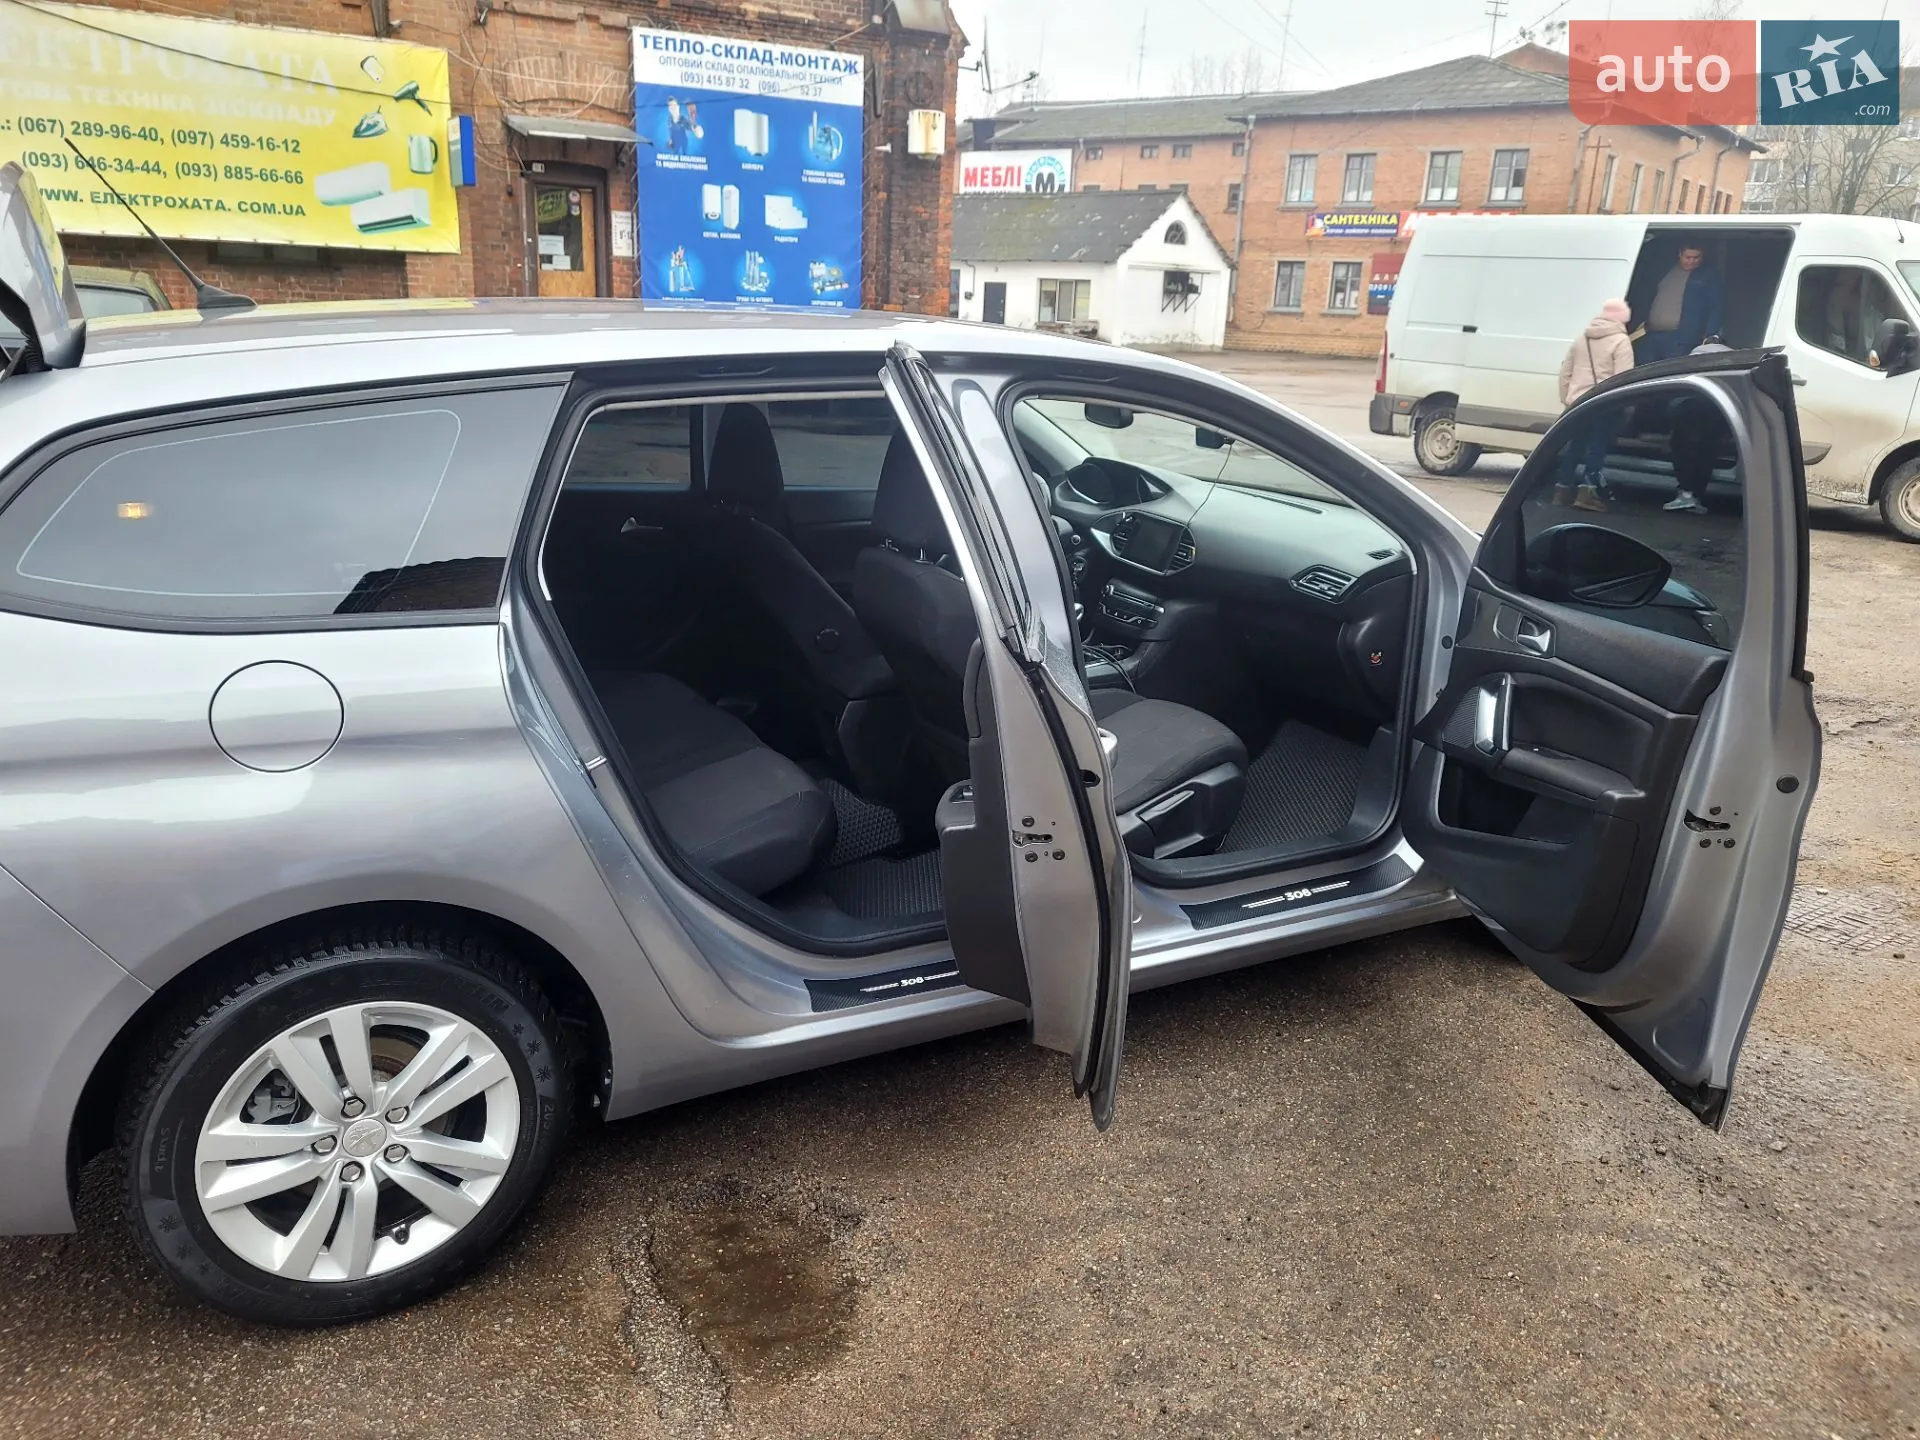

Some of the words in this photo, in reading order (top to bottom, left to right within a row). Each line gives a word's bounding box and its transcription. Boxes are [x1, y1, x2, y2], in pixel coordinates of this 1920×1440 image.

[640, 34, 858, 74] ТЕПЛО-СКЛАД-МОНТАЖ
[681, 72, 704, 86] (093)
[706, 74, 723, 86] 415
[725, 76, 736, 87] 87
[739, 78, 750, 89] 32
[17, 116, 65, 138] (067)
[70, 120, 165, 146] 289-96-40,
[171, 128, 215, 150] (097)
[220, 132, 301, 154] 459-16-12
[22, 151, 69, 172] (093)
[74, 154, 168, 179] 646-34-44,
[175, 161, 218, 182] (093)
[223, 164, 305, 185] 885-66-66
[964, 165, 1022, 188] МЕБЛІ
[237, 199, 307, 217] COM.UA
[1323, 213, 1398, 225] САНТЕХНІКА
[1284, 887, 1313, 902] 308
[900, 976, 925, 988] 308
